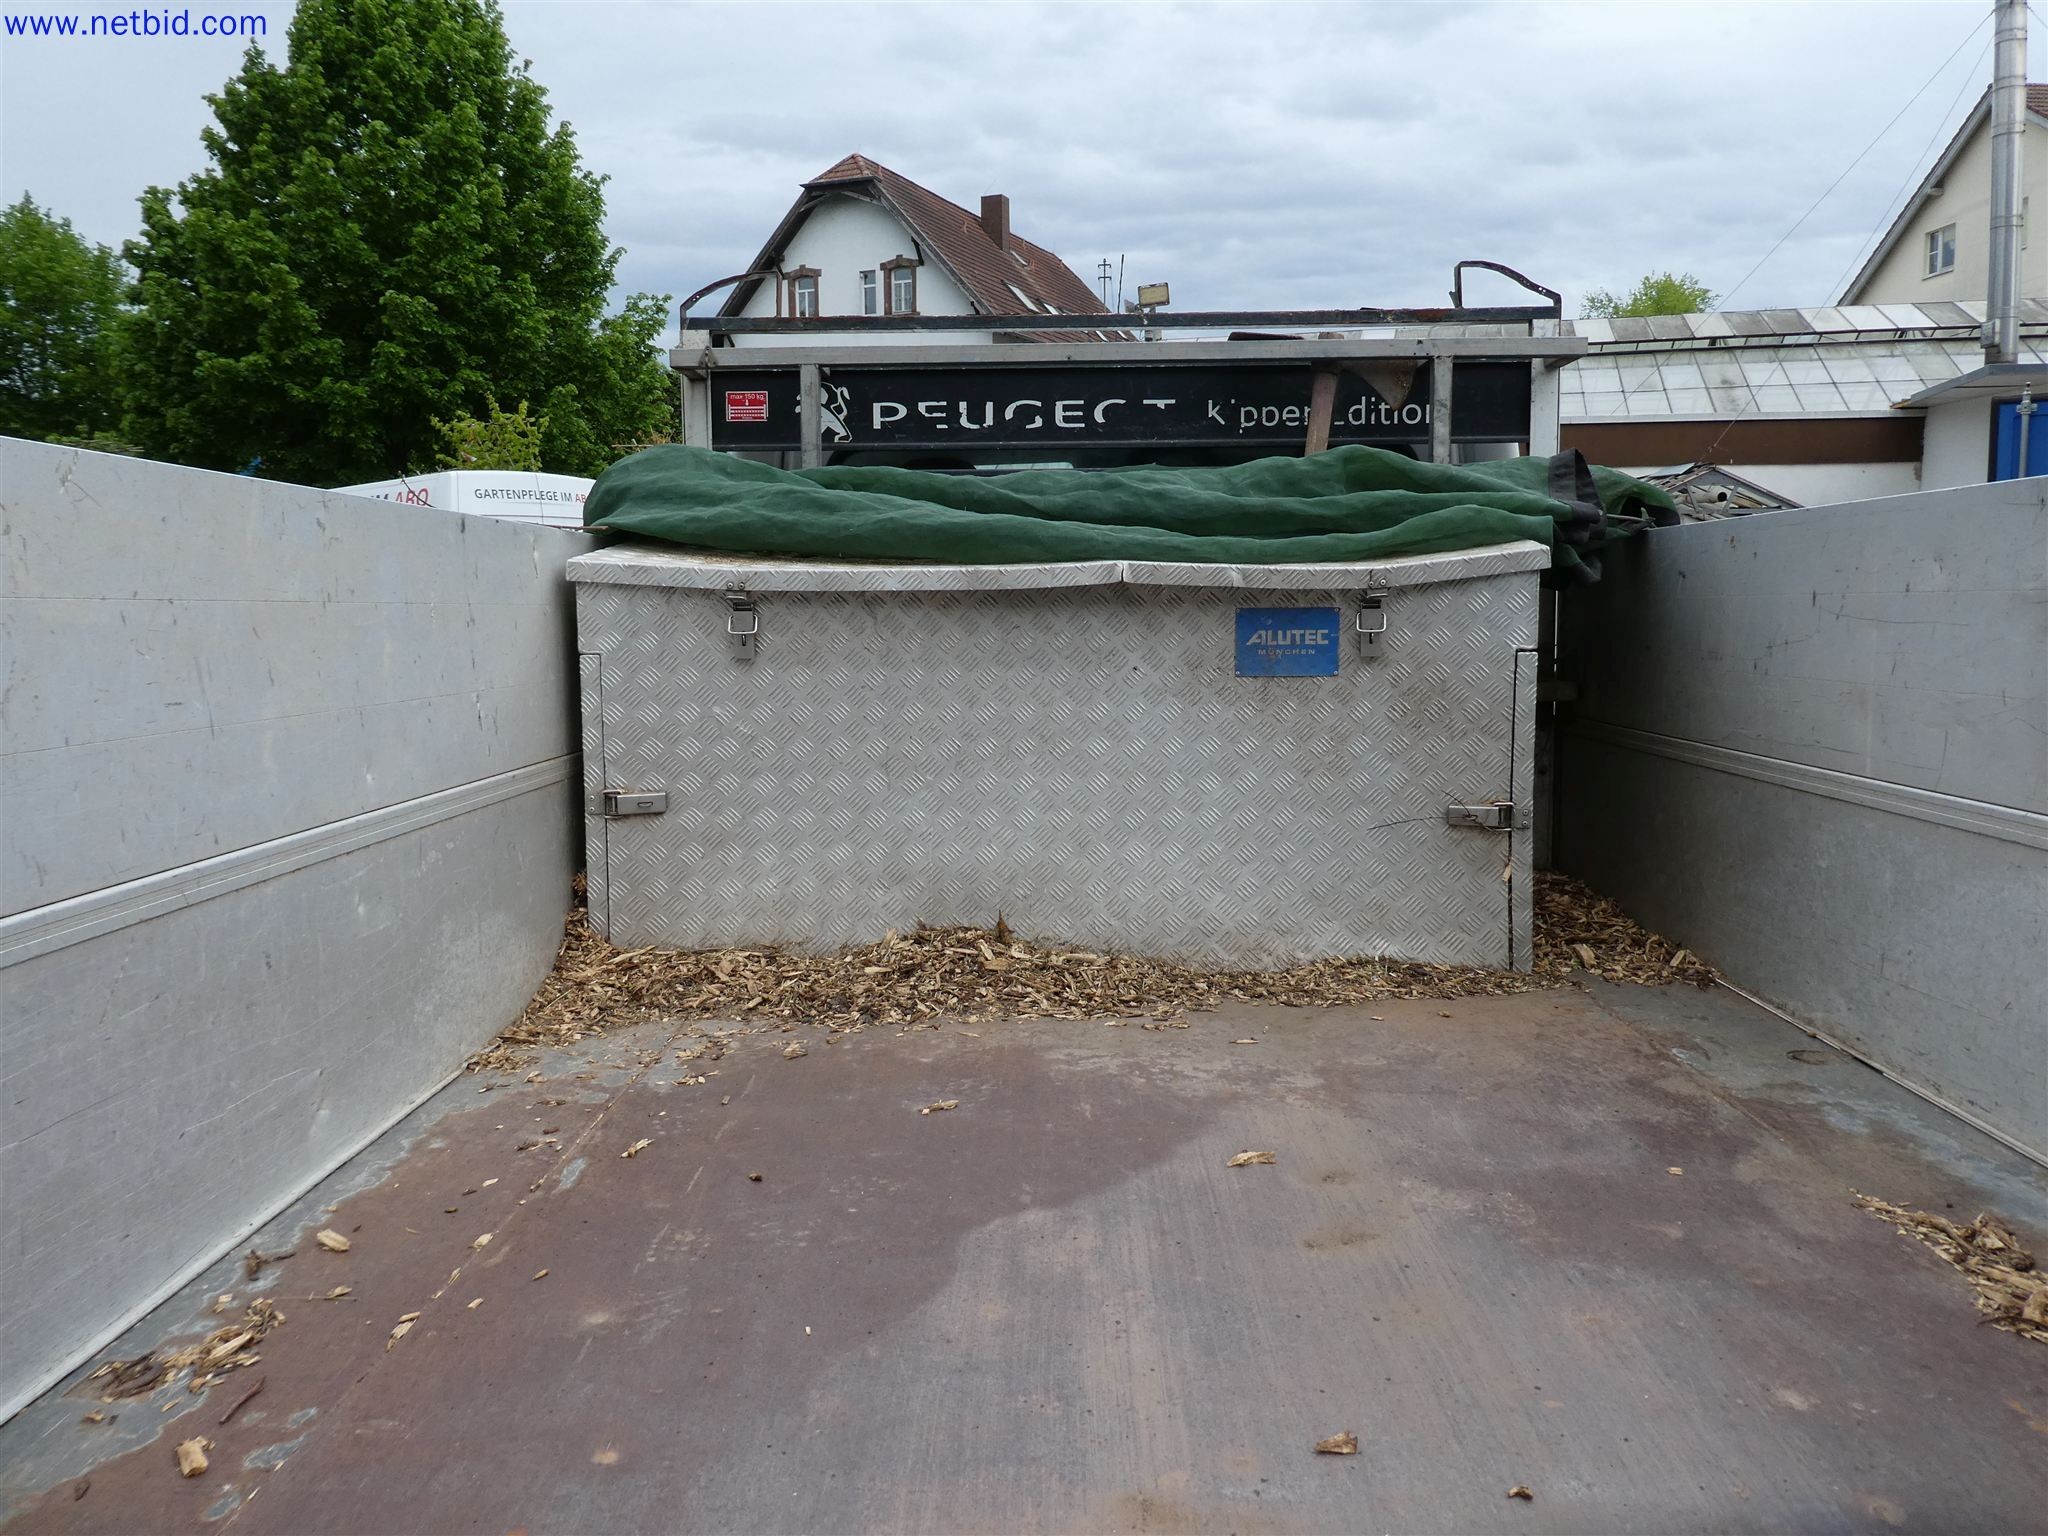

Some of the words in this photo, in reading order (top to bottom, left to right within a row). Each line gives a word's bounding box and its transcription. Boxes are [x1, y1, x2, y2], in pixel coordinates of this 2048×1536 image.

[1208, 399, 1311, 434] kpper
[1334, 396, 1430, 425] ditio
[474, 489, 558, 501] GARTENPFLEGE
[560, 492, 573, 502] IM
[575, 494, 587, 504] AB
[1246, 629, 1329, 645] ALUTEC
